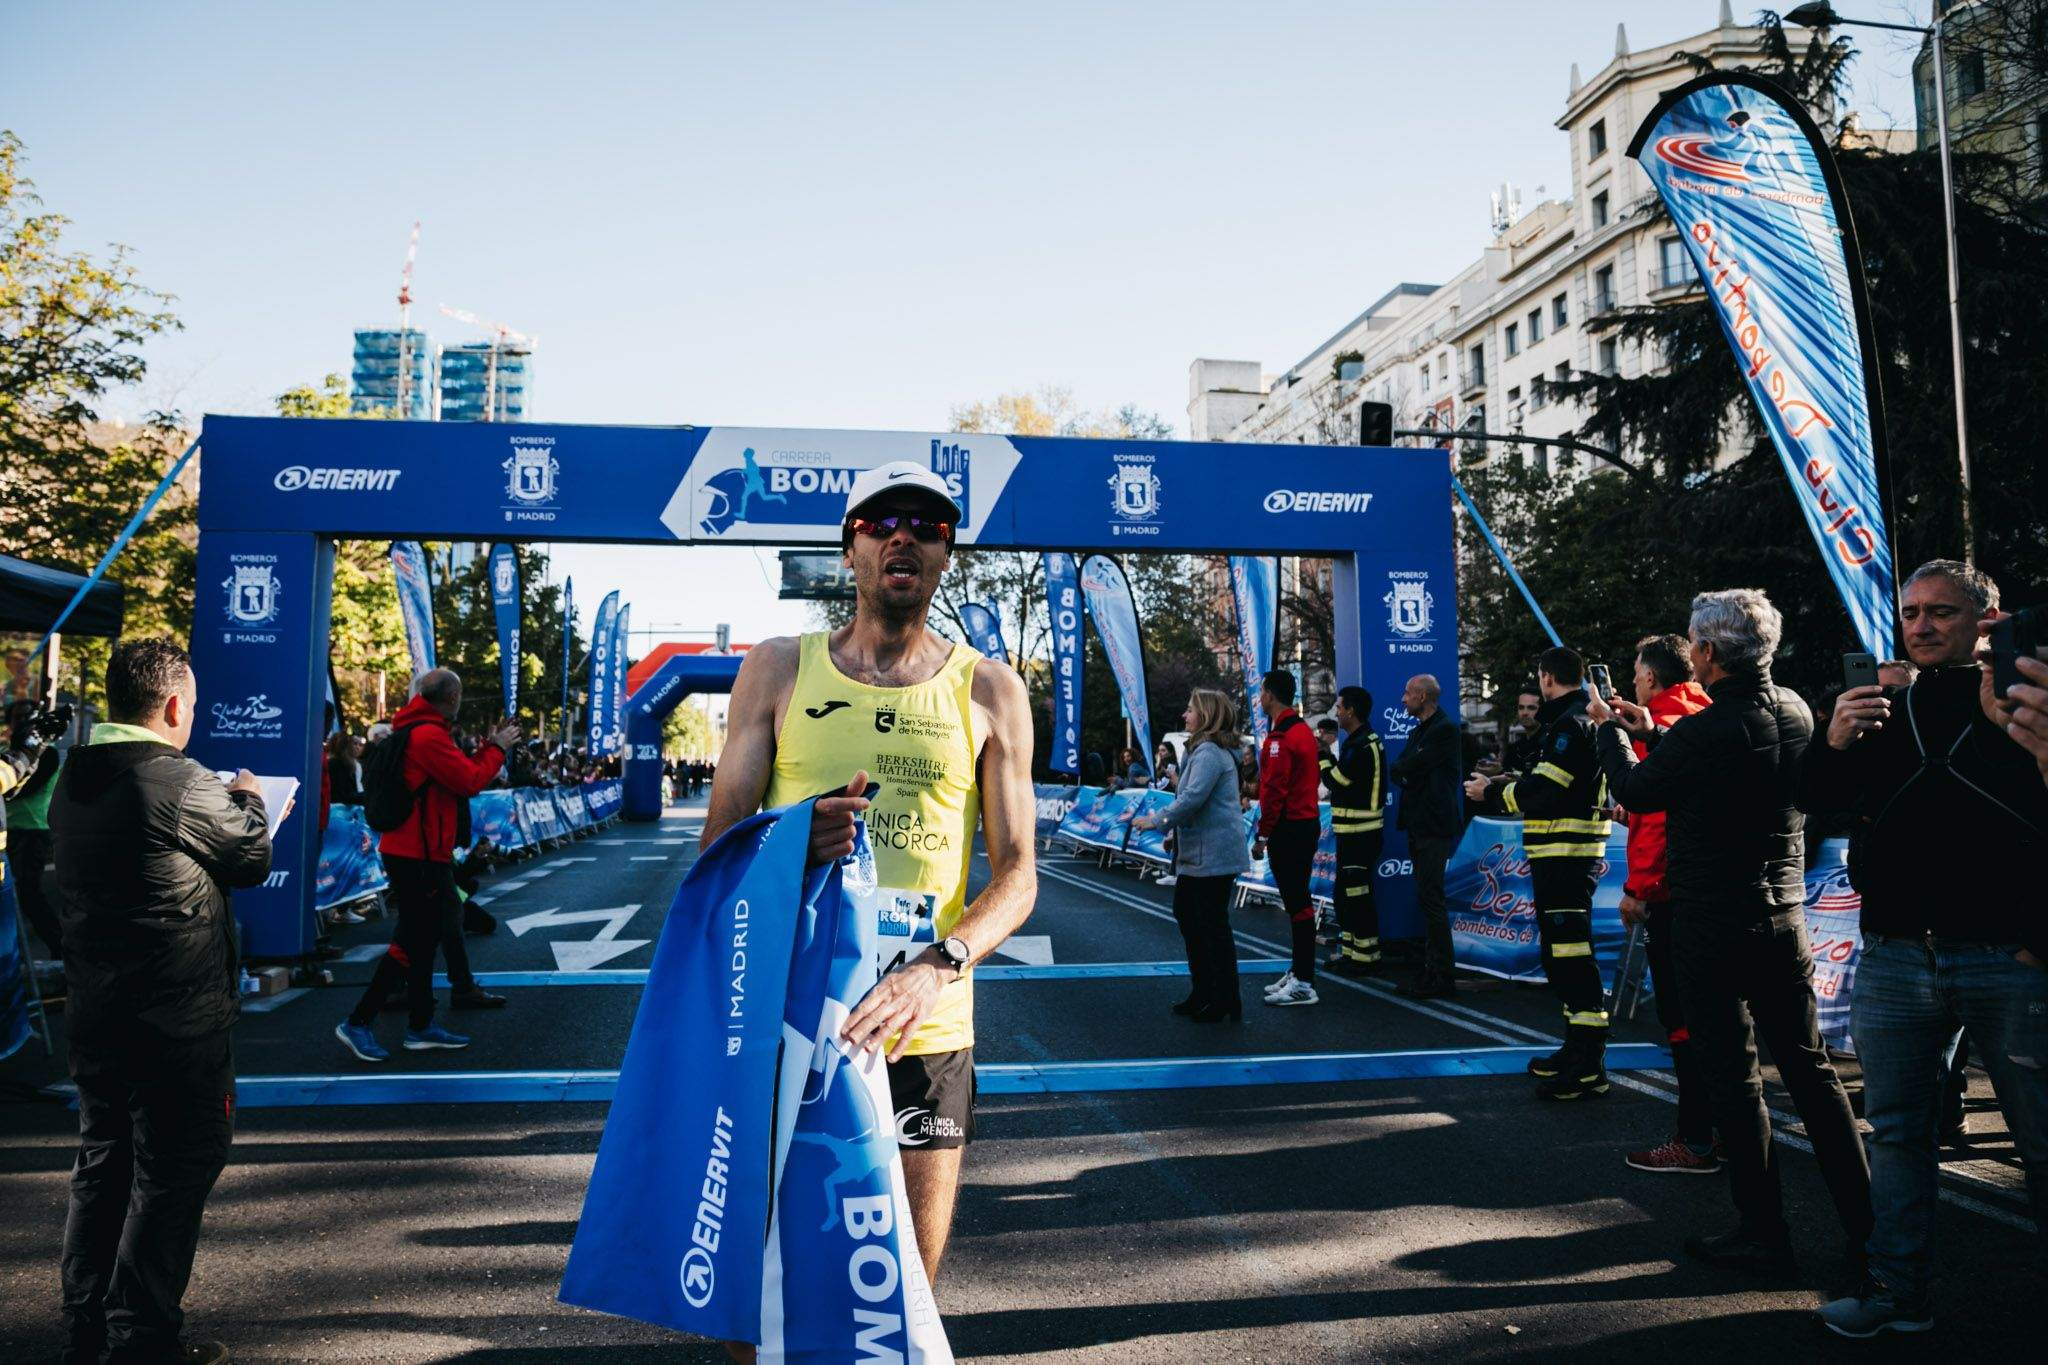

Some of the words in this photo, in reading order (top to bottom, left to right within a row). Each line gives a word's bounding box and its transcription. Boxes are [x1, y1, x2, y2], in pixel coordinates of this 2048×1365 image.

[509, 436, 556, 446] BOMBEROS
[771, 449, 832, 465] CARRERA
[1113, 454, 1156, 463] BOMBEROS
[308, 468, 402, 491] ENERVIT
[1293, 491, 1373, 514] ENERVIT
[517, 512, 556, 521] MADRID
[1124, 526, 1160, 535] MADRID
[230, 554, 278, 563] BOMBEROS
[1388, 571, 1429, 579] BOMBEROS
[236, 634, 277, 643] MADRID
[1399, 644, 1434, 653] MADRID
[591, 629, 606, 756] BOMBEROS
[651, 675, 680, 704] MADRID
[211, 702, 243, 716] Club
[217, 713, 282, 733] Deportivo
[899, 717, 916, 726] San
[898, 726, 911, 735] de
[911, 728, 923, 736] los
[925, 729, 950, 740] Reyes
[896, 787, 919, 798] Spain
[863, 808, 924, 832] LÍNICA
[868, 830, 949, 851] ENORCA
[1452, 914, 1518, 942] bomberos
[1519, 926, 1535, 944] de
[729, 899, 750, 1018] MADRID
[922, 1115, 955, 1127] CLÍNICA
[920, 1125, 964, 1137] MENORCA
[691, 1106, 734, 1254] ENERVIT
